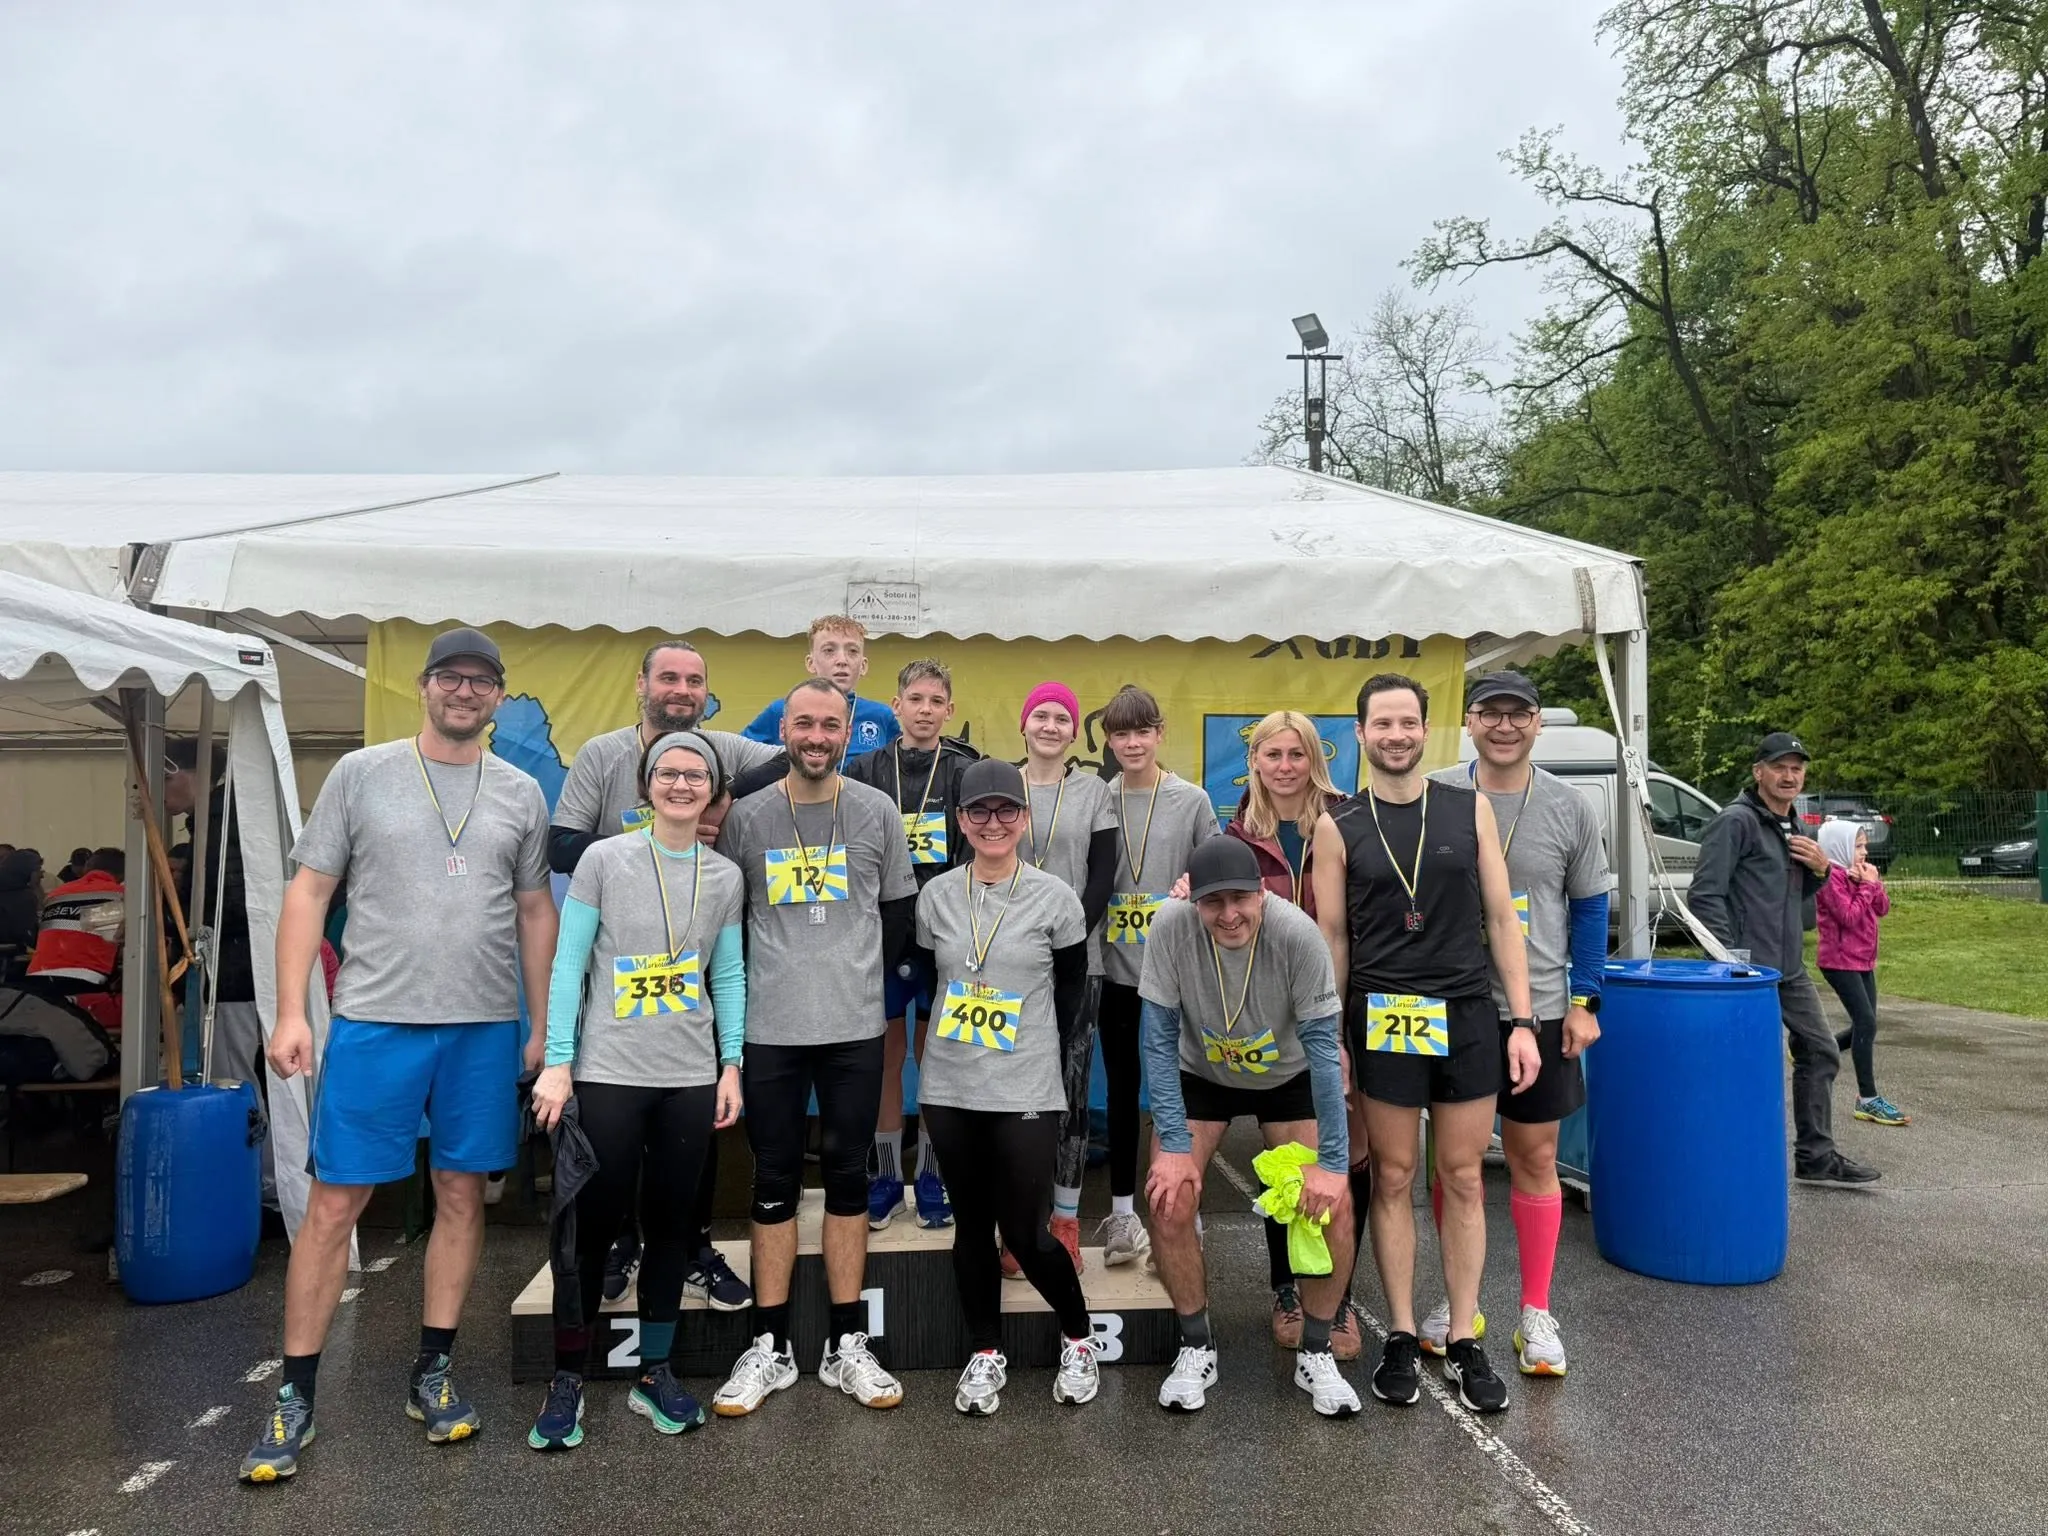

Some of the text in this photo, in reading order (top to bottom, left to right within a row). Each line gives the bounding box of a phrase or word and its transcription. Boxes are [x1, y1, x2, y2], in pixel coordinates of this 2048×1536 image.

[792, 866, 820, 886] 12
[951, 1002, 1006, 1031] 400
[1384, 1013, 1431, 1038] 212
[860, 1288, 884, 1336] 1
[608, 1318, 641, 1367] 2
[1088, 1313, 1124, 1361] 3
